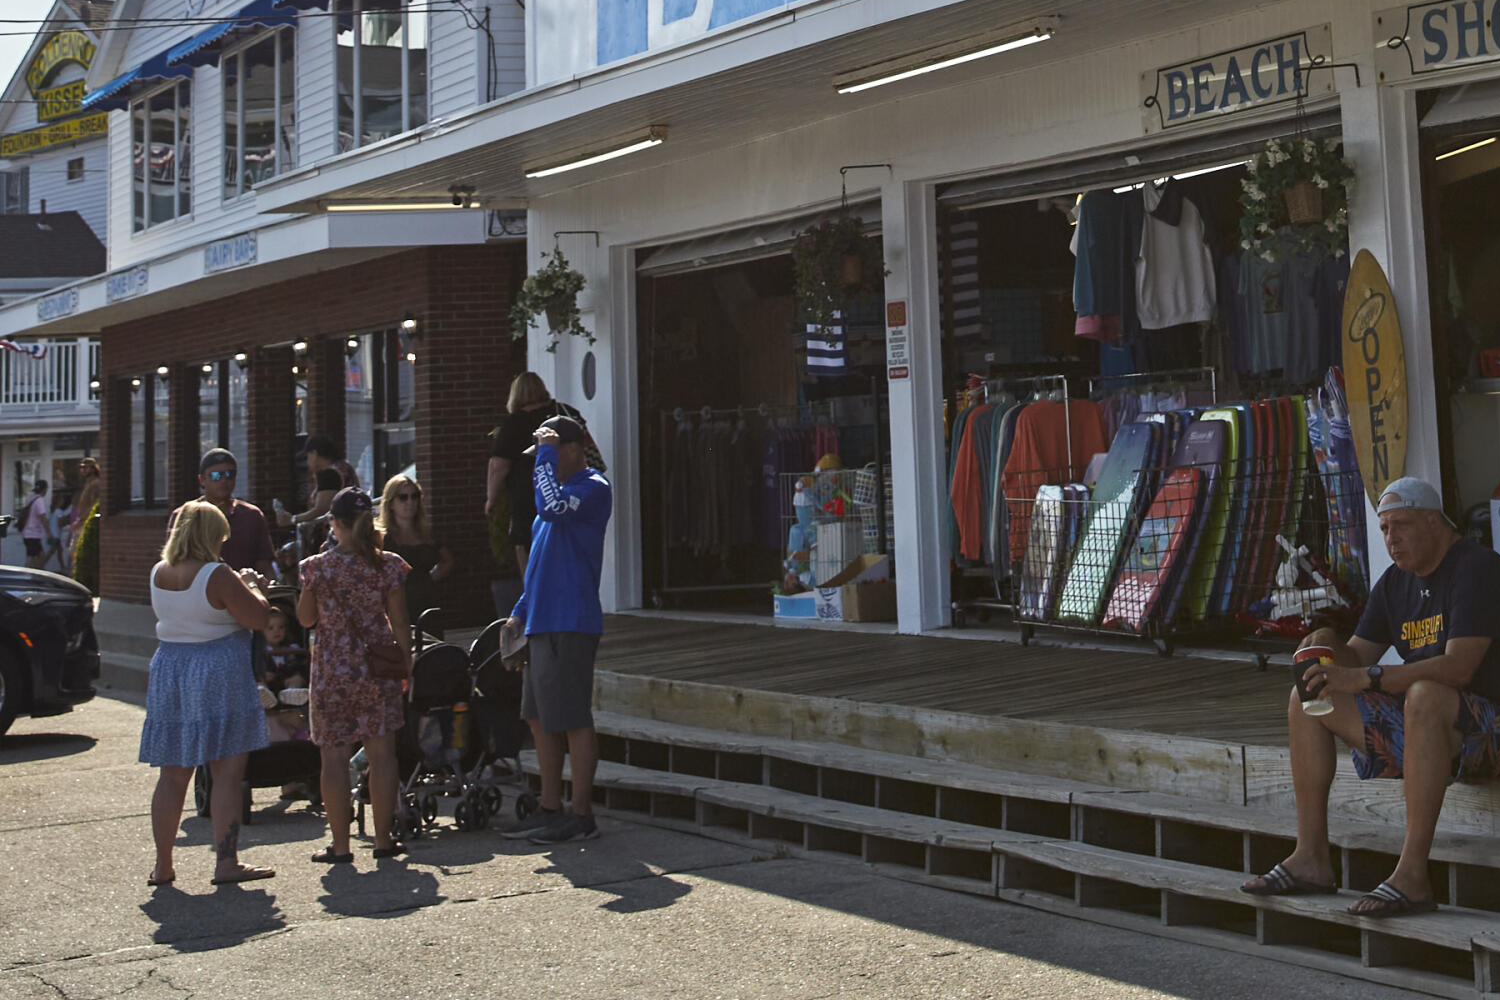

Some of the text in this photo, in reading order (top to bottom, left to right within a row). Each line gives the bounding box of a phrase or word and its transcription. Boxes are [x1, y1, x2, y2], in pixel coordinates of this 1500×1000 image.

[1163, 39, 1302, 122] BEACH
[1361, 327, 1390, 483] OPEN
[533, 464, 569, 515] Columbia
